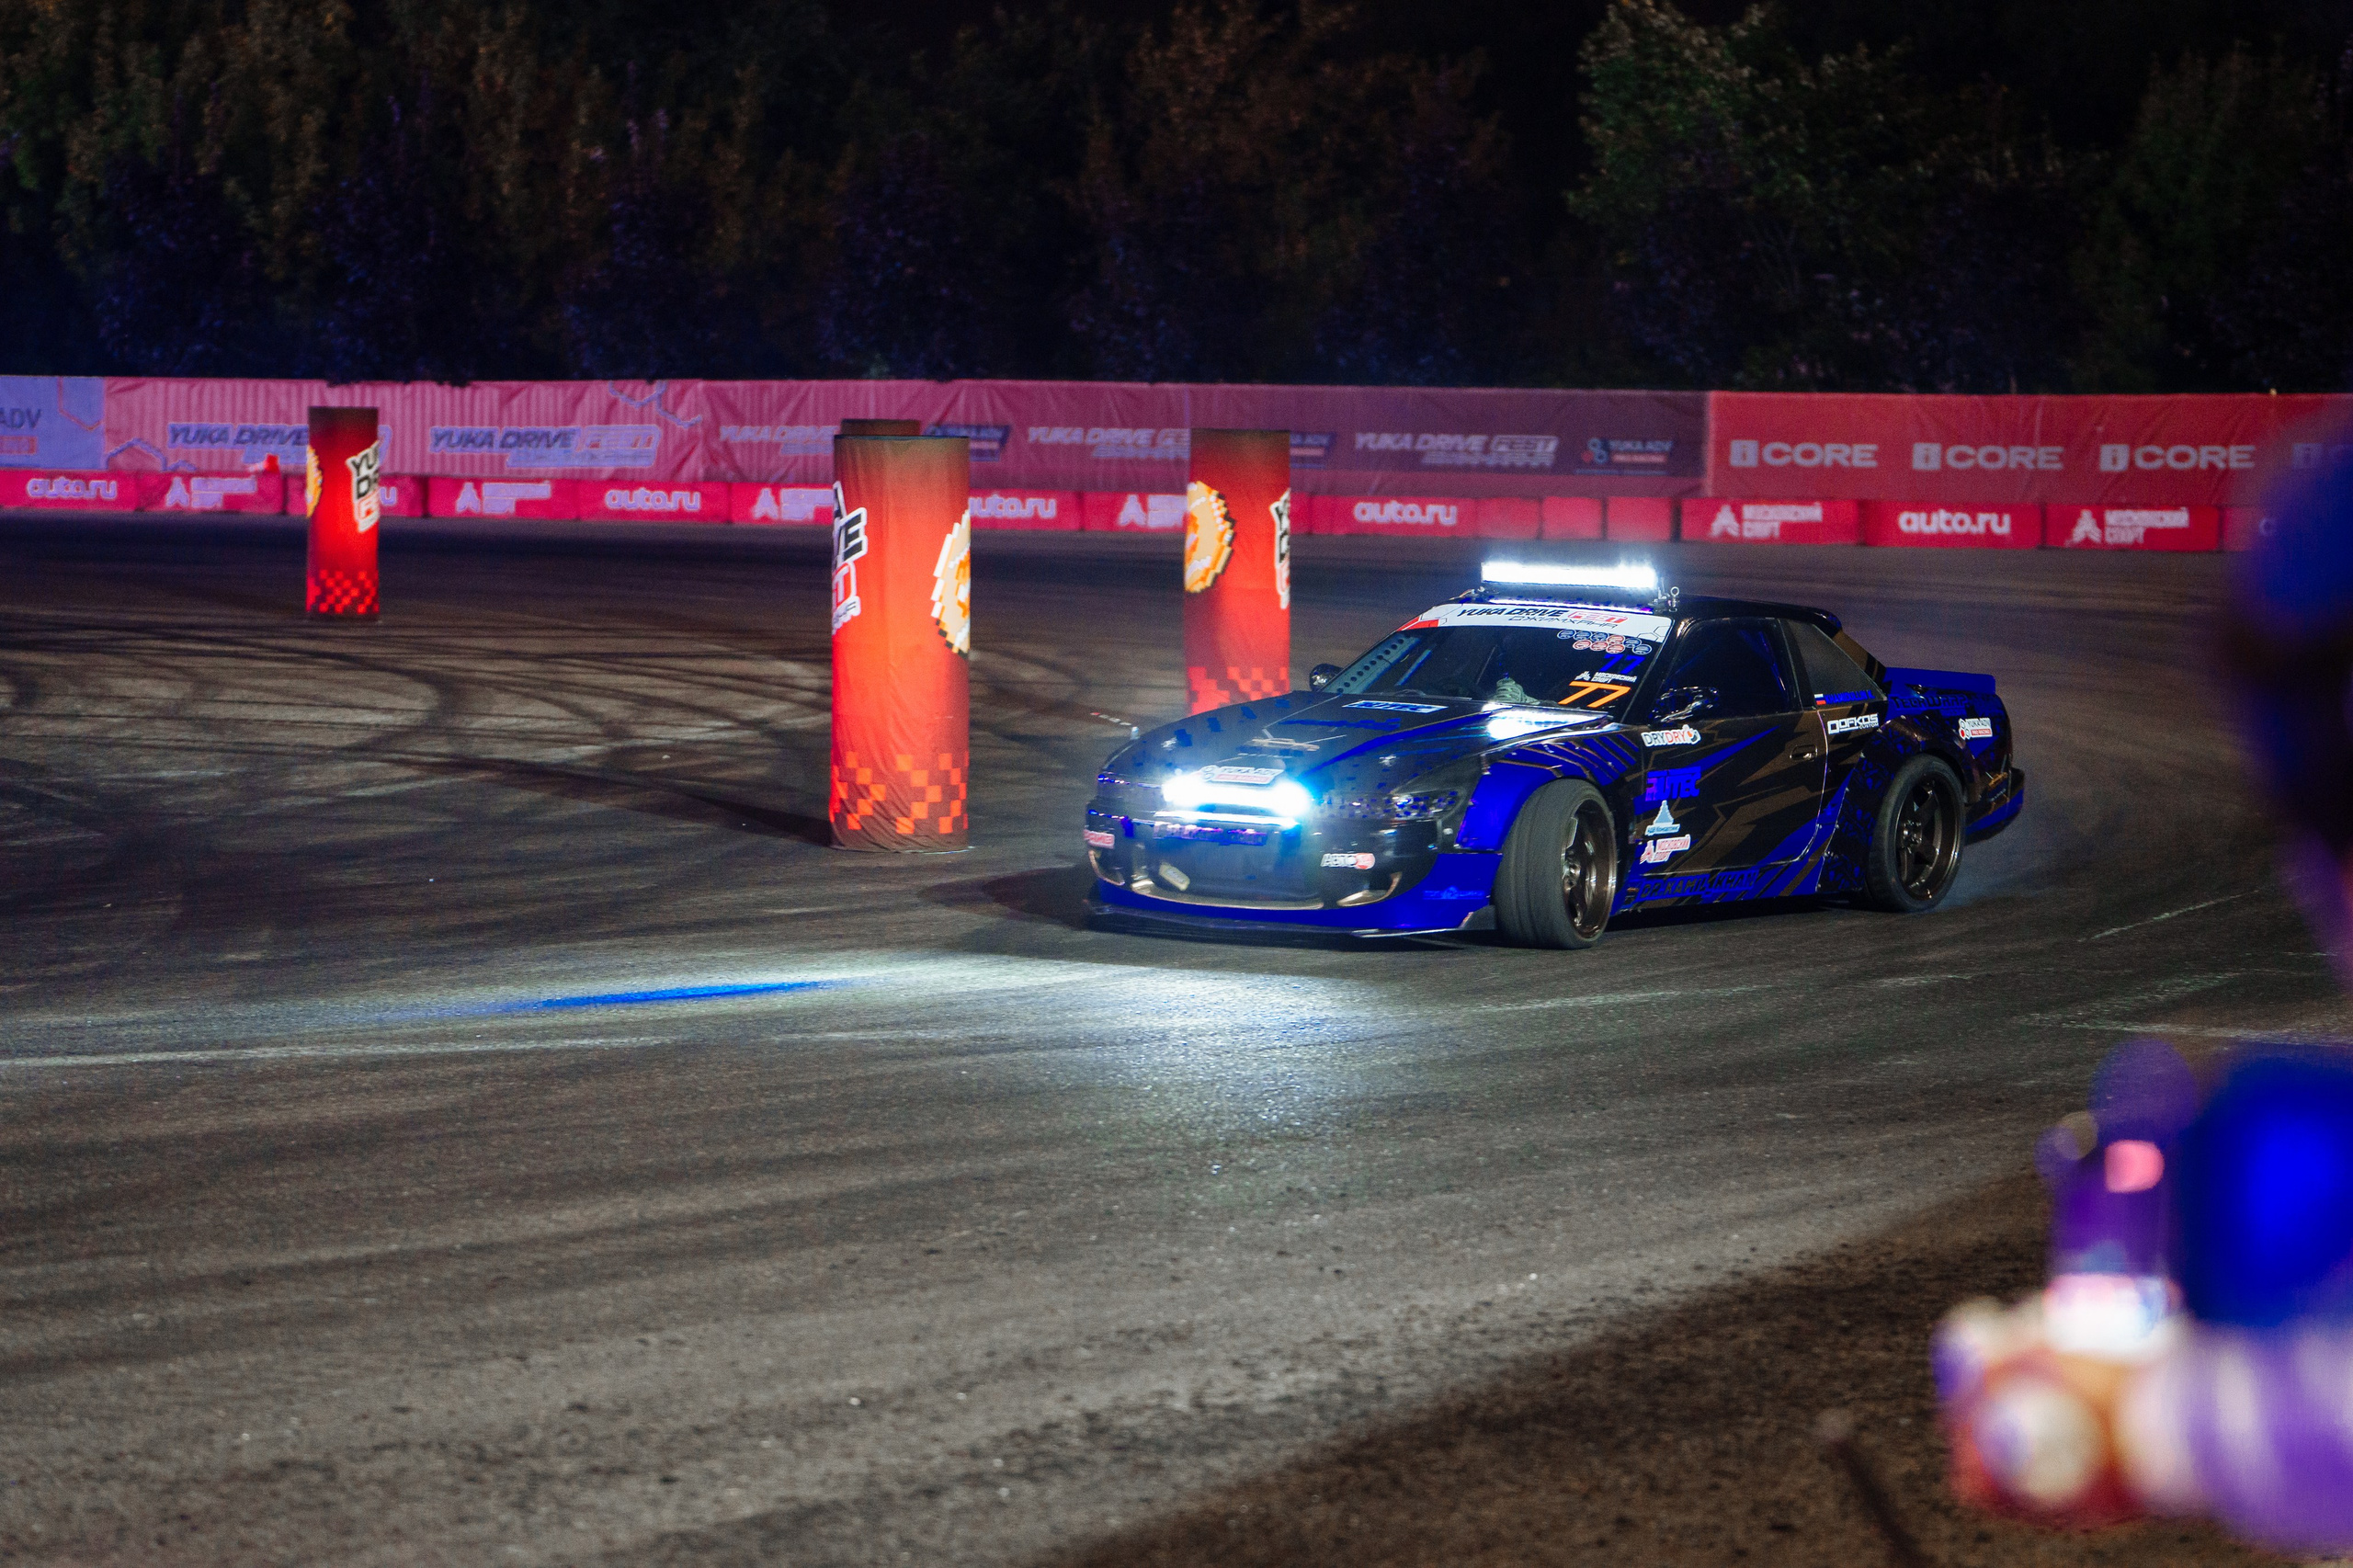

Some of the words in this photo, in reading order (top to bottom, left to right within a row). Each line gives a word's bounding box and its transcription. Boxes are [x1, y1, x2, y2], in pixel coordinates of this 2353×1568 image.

[432, 429, 495, 449] YUKA
[498, 428, 577, 449] DRIVE
[1355, 432, 1413, 449] YUKA
[1415, 434, 1487, 451] DRIVE
[1761, 441, 1879, 468] CORE
[1945, 444, 2064, 471] CORE
[2133, 445, 2256, 470] CORE
[27, 476, 117, 499] auto.ru
[605, 488, 700, 512] auto.ru
[1354, 501, 1457, 526] auto.ru
[1898, 508, 2011, 535] auto.ru
[1457, 607, 1506, 618] YUKA
[1506, 608, 1569, 618] DRIVE
[1599, 653, 1646, 675] 77
[1557, 680, 1631, 709] 77
[1644, 732, 1687, 744] DRYDRY
